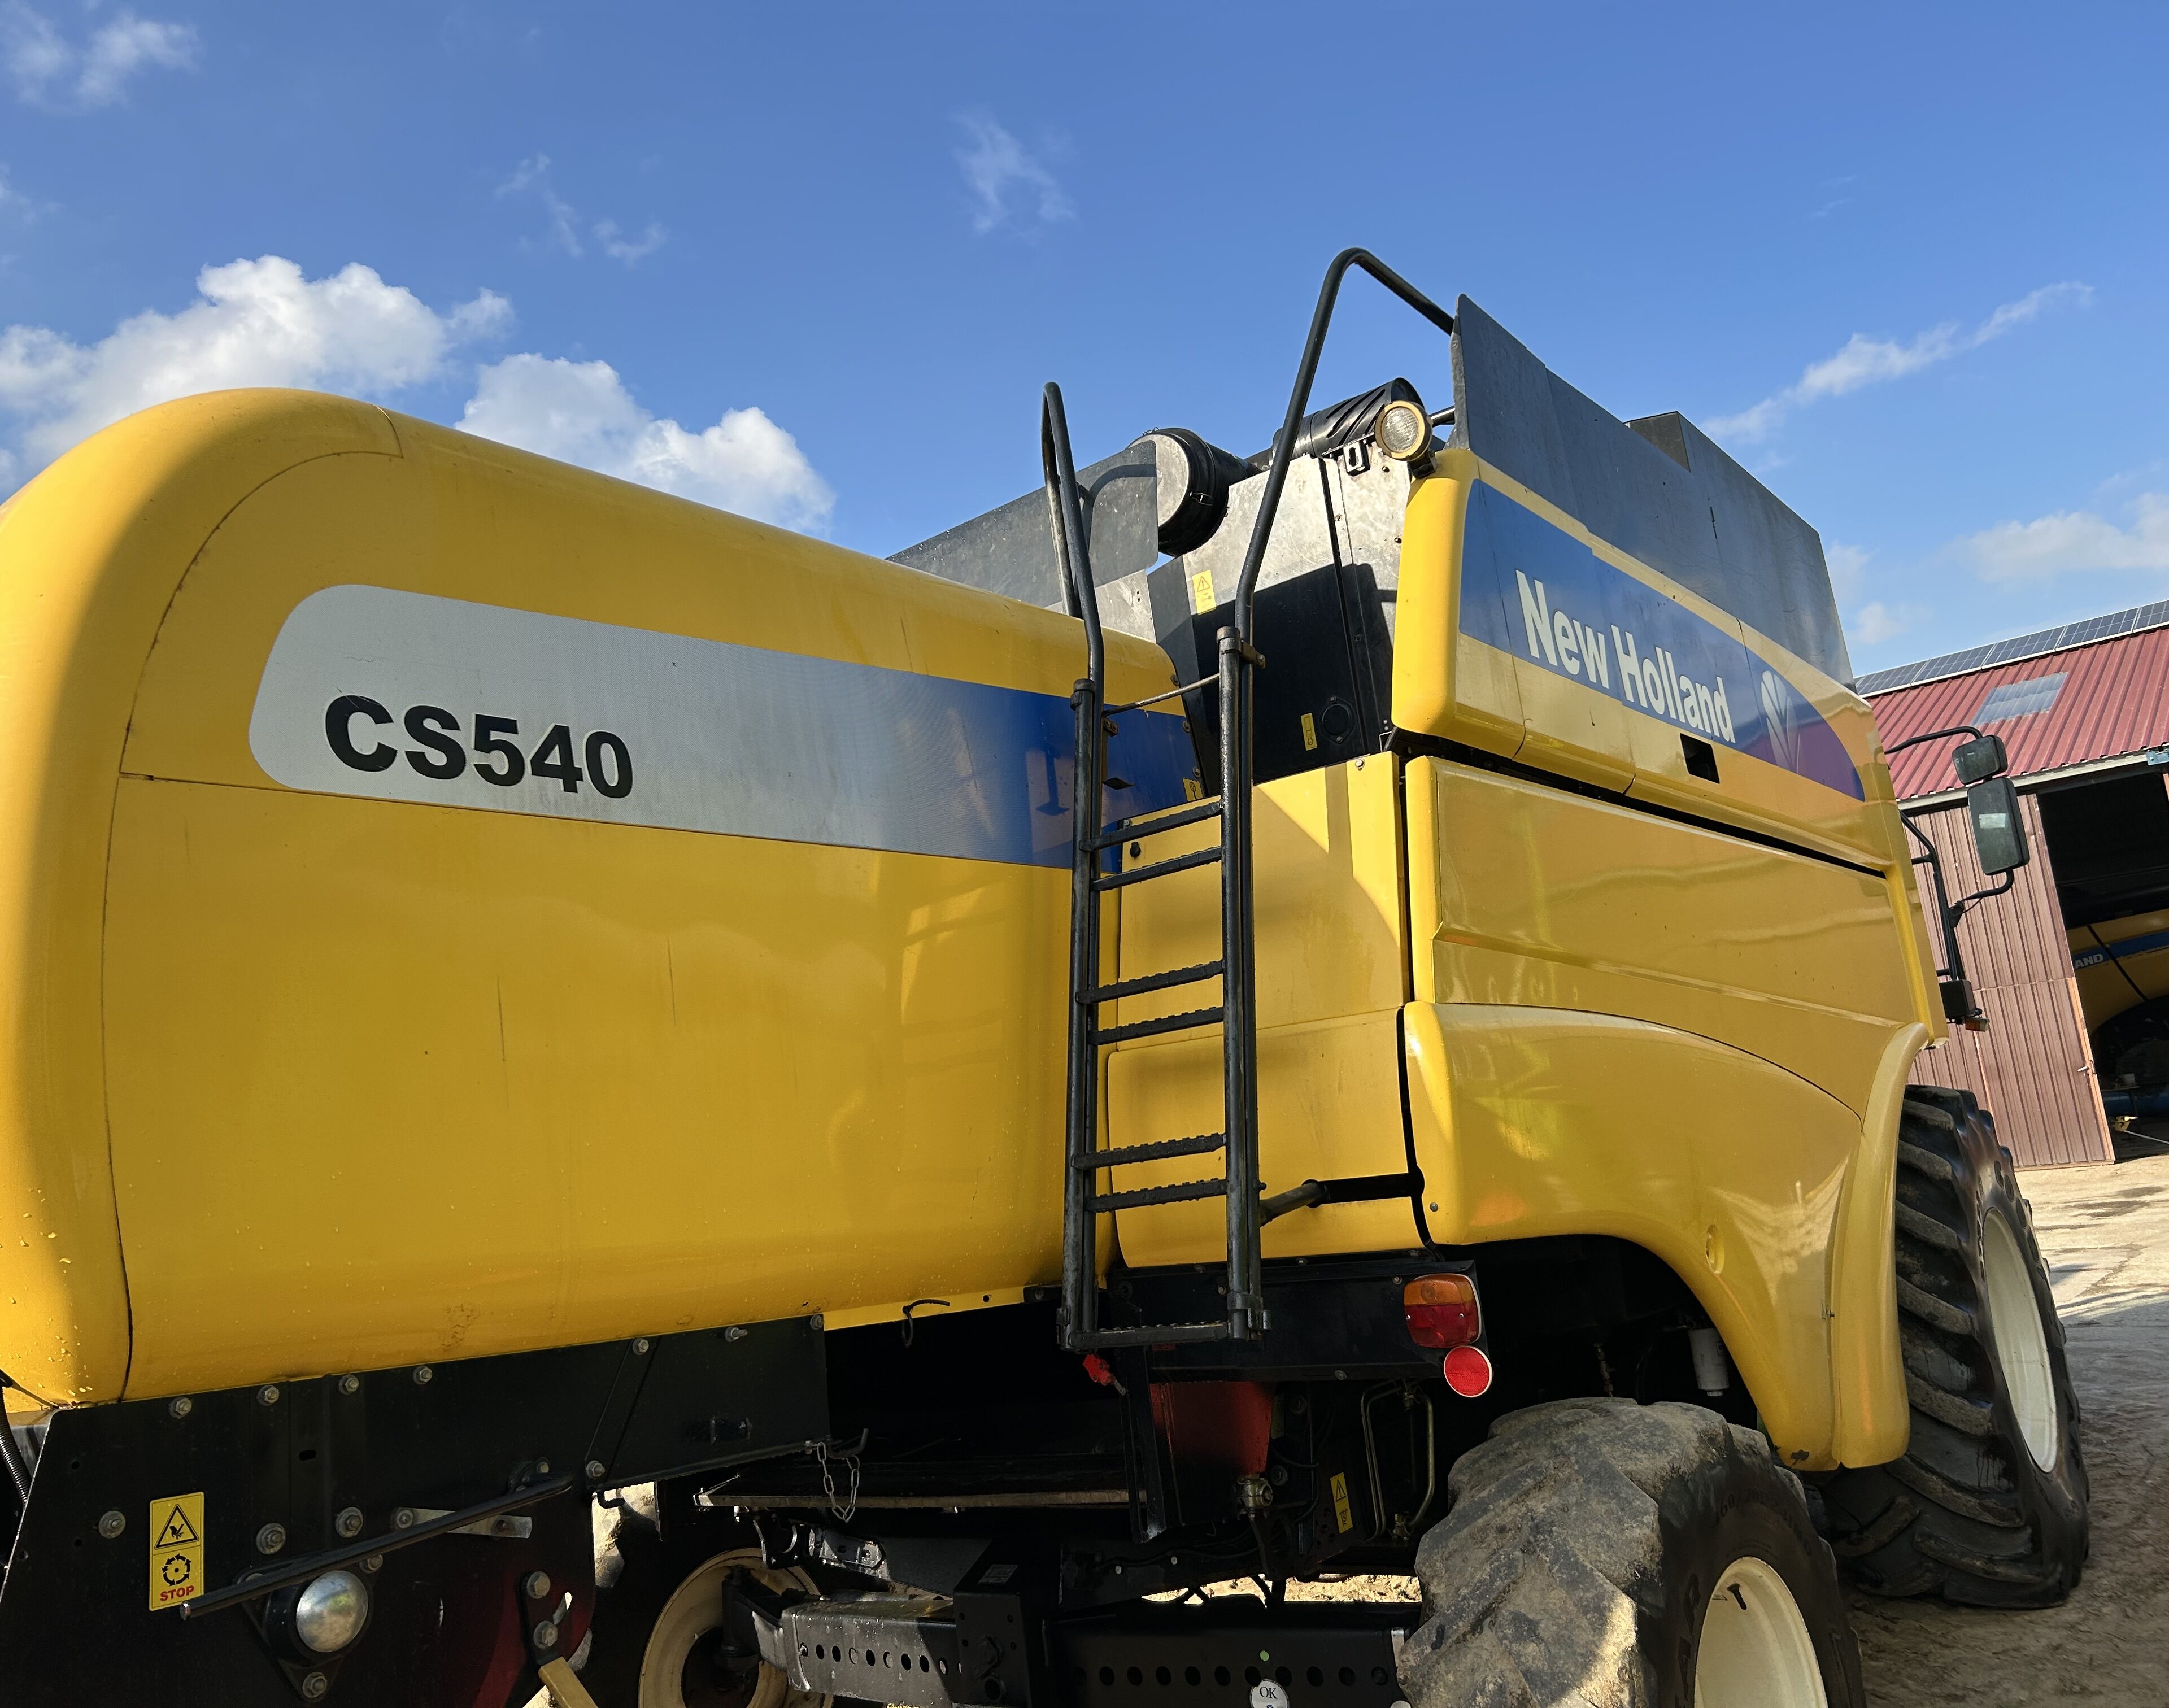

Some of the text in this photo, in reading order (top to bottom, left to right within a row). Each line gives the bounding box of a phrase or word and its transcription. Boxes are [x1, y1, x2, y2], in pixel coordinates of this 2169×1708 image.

[1515, 569, 1736, 743] New Holland
[325, 694, 633, 799] CS540
[160, 1585, 195, 1602] STOP
[1259, 1686, 1278, 1700] OK
